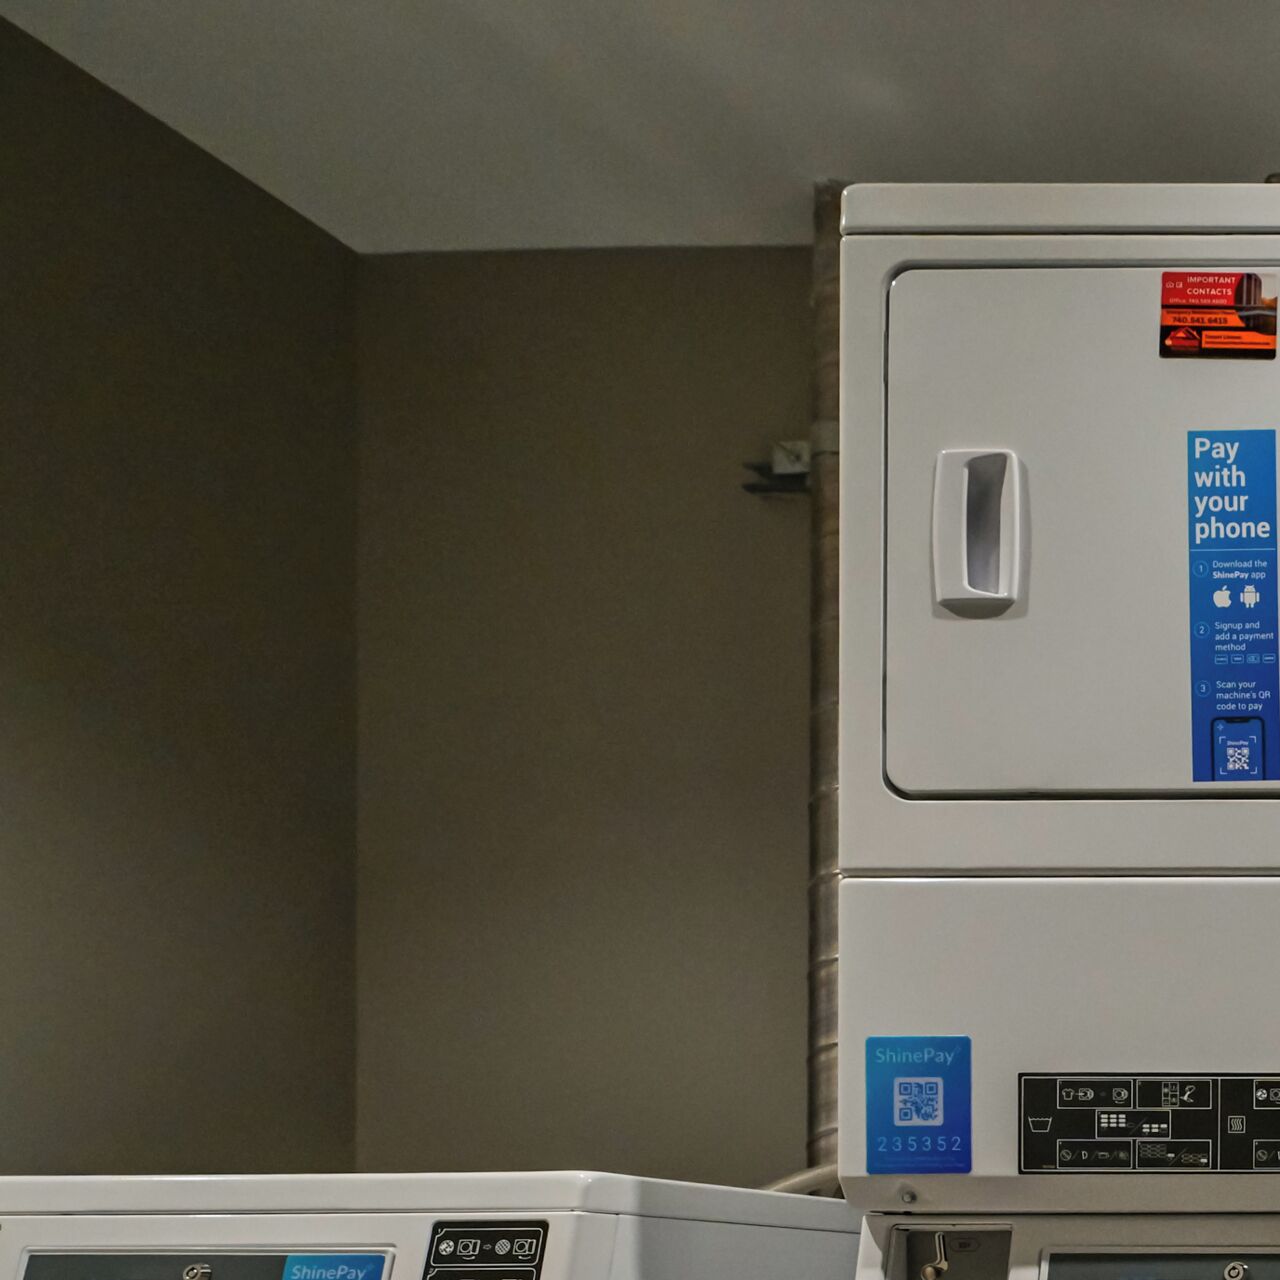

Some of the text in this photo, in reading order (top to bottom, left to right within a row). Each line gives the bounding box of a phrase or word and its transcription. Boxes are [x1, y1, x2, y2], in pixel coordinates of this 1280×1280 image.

[1195, 438, 1239, 463] Pay
[1195, 465, 1246, 487] with
[1194, 496, 1248, 517] your
[1195, 517, 1270, 544] phone
[1255, 560, 1267, 568] the
[1212, 571, 1248, 579] ShinePay
[1215, 622, 1242, 630] Signup
[1239, 632, 1274, 641] payment
[1215, 643, 1246, 651] method
[1239, 682, 1256, 690] your
[1259, 691, 1270, 700] QR
[1248, 703, 1263, 712] pay
[876, 1048, 954, 1065] ShinePay
